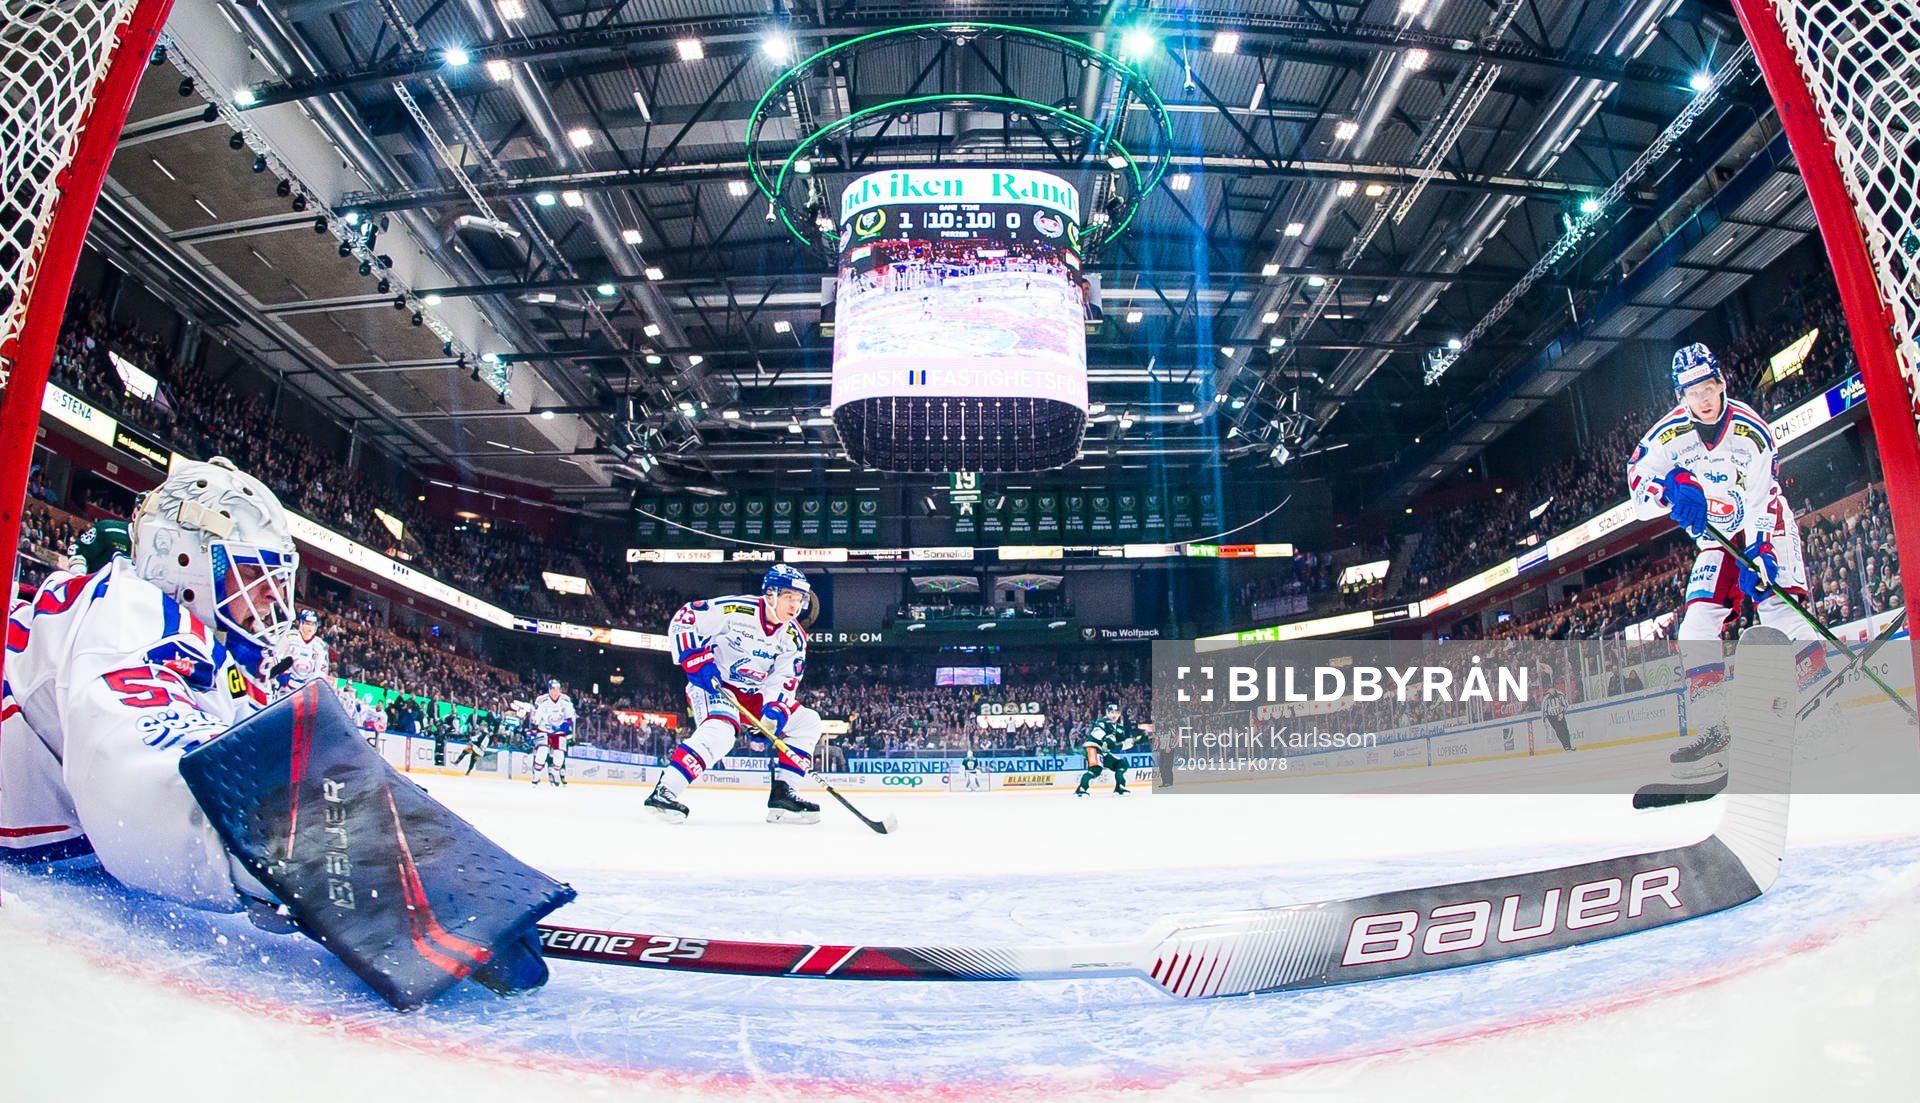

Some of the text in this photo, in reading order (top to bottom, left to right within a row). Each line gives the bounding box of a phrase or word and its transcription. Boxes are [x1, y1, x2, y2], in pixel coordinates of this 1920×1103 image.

[898, 212, 913, 228] 1
[927, 212, 992, 228] 10:10
[1006, 212, 1021, 228] 0
[61, 393, 92, 422] STENA
[807, 633, 882, 642] KER ROOM
[1101, 628, 1160, 639] The Wolfpack
[709, 774, 740, 784] Thermia
[882, 776, 923, 788] coop
[639, 935, 709, 963] 25
